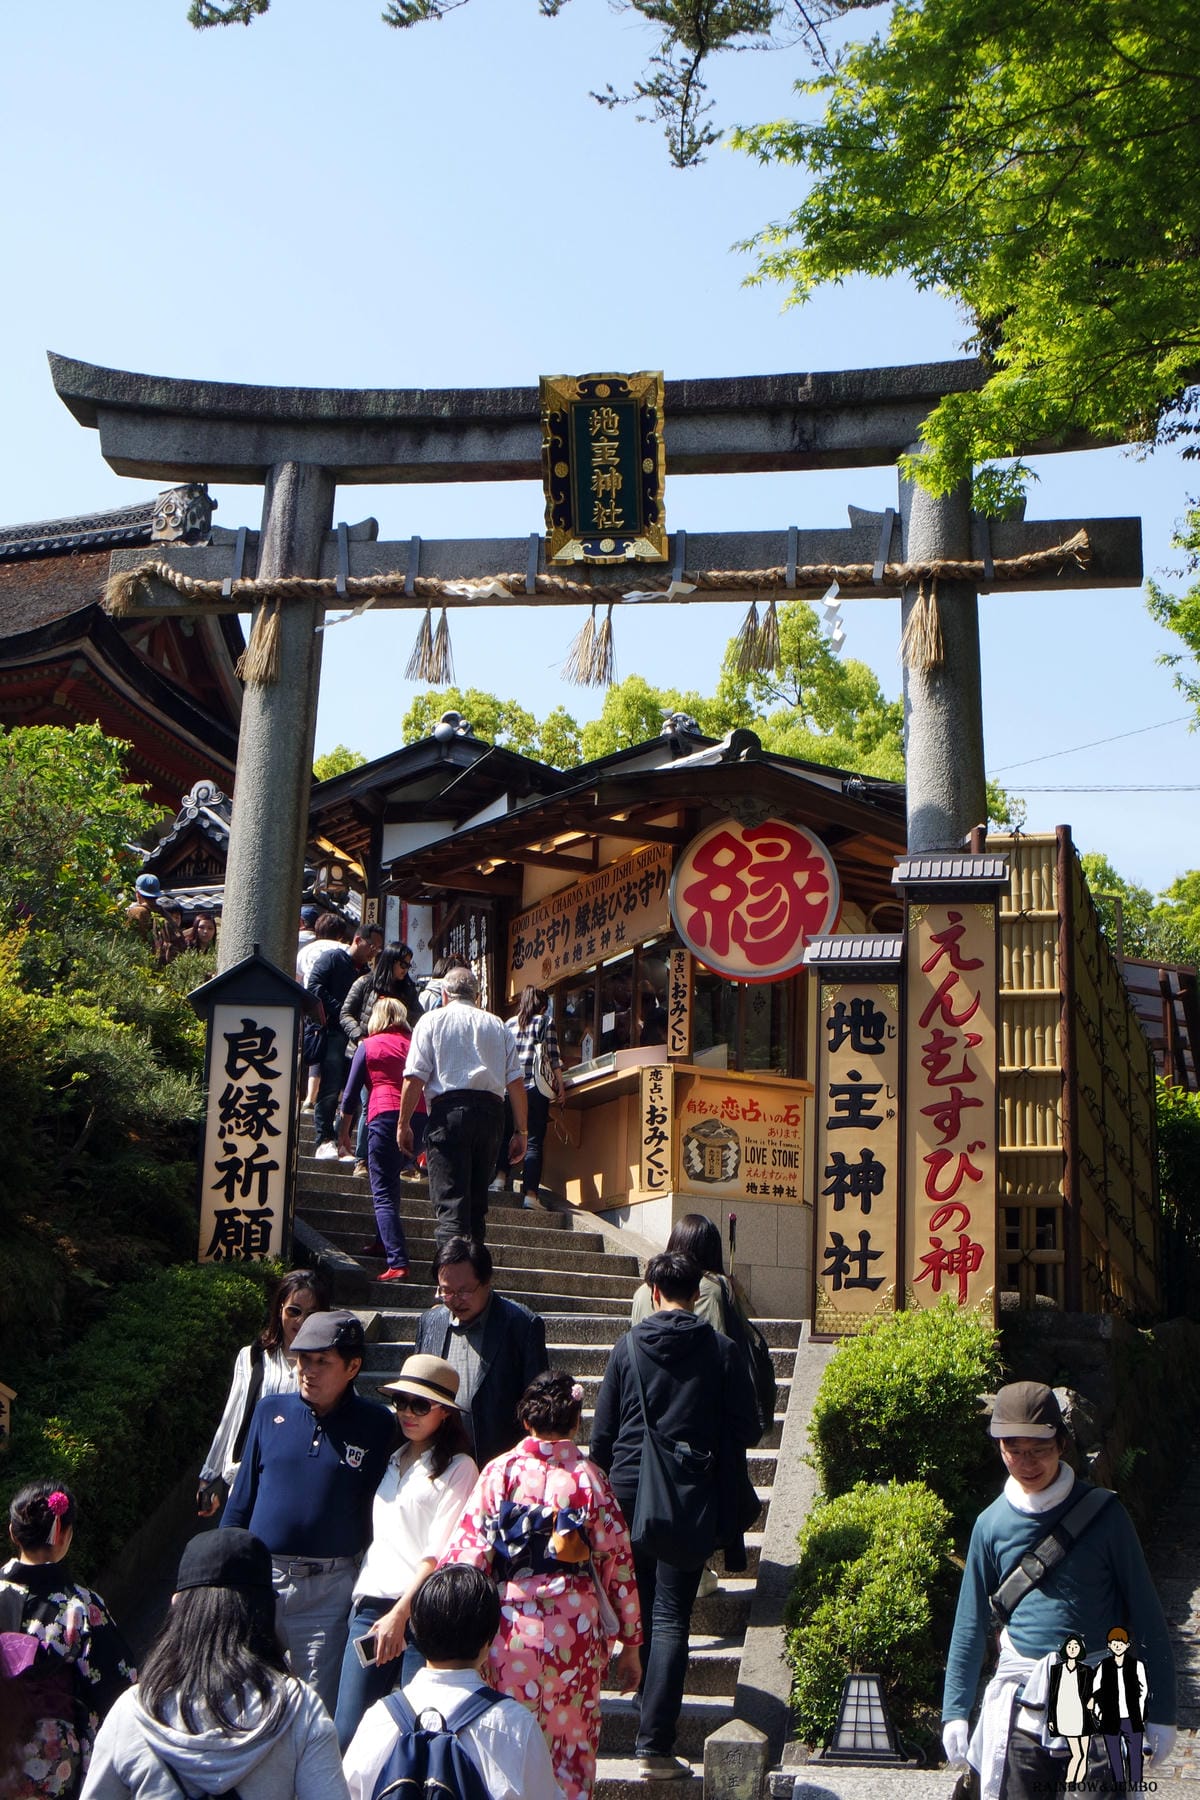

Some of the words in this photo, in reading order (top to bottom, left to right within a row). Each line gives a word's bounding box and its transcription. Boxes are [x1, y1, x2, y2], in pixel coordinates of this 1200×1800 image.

[588, 406, 625, 530] 地主神社
[511, 916, 530, 937] GOOD
[531, 906, 550, 926] LUCK
[552, 890, 583, 915] CHARMS
[585, 874, 610, 898] KYOTO
[636, 845, 668, 872] SHRINE
[683, 821, 830, 966] 縁
[511, 914, 570, 971] 恋のお守り
[669, 951, 689, 1053] 恋占いおみくじ
[205, 1018, 283, 1261] 良縁祈願
[643, 1068, 670, 1188] 恋占いおみくじ
[685, 1096, 801, 1126] 有名な恋占いの石
[745, 1146, 767, 1165] LOVE
[771, 1148, 800, 1169] STONE
[820, 997, 888, 1293] 地主神社
[913, 911, 987, 1307] えんむすびの神
[745, 1166, 798, 1182] えんむすびの神
[745, 1181, 798, 1198] 地主神社
[348, 1448, 362, 1462] PG
